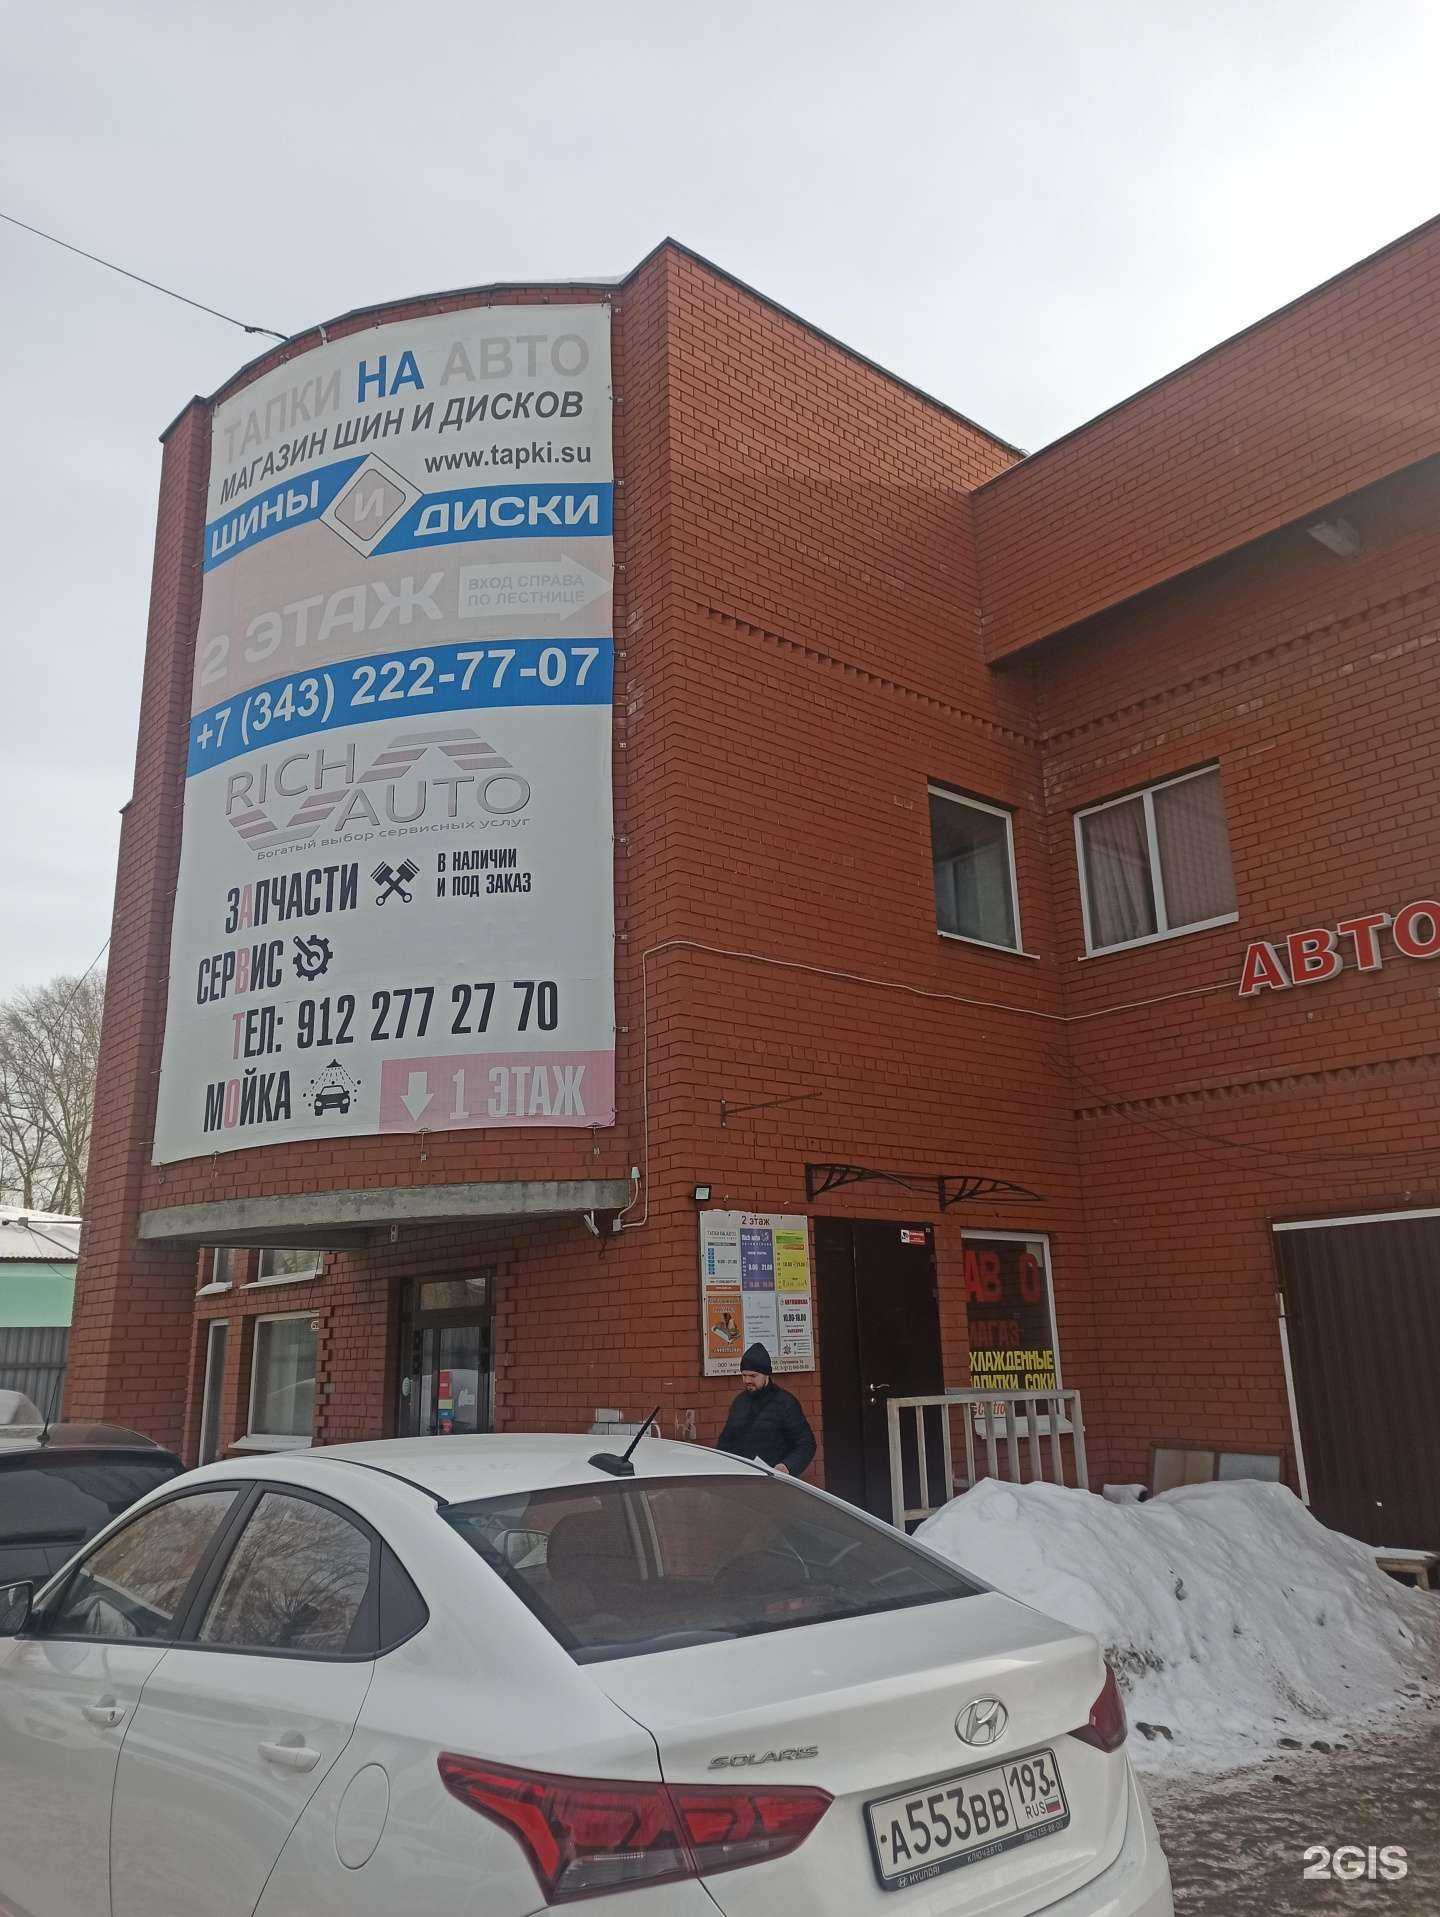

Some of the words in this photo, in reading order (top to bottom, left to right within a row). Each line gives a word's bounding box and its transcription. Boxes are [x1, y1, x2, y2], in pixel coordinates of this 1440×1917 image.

[223, 369, 341, 463] ТАПКИ
[357, 351, 424, 402] НА
[439, 334, 589, 386] АВТО
[220, 428, 327, 505] МАГАЗИН
[333, 407, 401, 450] ШИН
[411, 402, 434, 432] И
[438, 390, 584, 434] ДИСКОВ
[424, 442, 592, 474] www.tapki.su
[211, 479, 319, 558] ШИНЫ
[354, 487, 385, 522] И
[413, 494, 599, 537] ДИСКИ
[467, 576, 514, 592] ВХОД
[517, 574, 585, 589] СПРАВА
[467, 591, 490, 606] ПО
[494, 588, 587, 606] ЛЕСТНИЦЕ
[201, 633, 230, 684] 2
[244, 571, 445, 662] ЭТАЖ
[196, 706, 232, 751] +7
[241, 673, 335, 741] (343)
[350, 646, 600, 707] 222-77-07
[225, 743, 357, 815] RICH
[333, 772, 532, 832] AUTO
[257, 838, 317, 861] Богатый
[320, 831, 374, 847] выбор
[378, 819, 475, 839] сервисных
[480, 816, 532, 830] услуг
[437, 852, 447, 872] В
[452, 848, 517, 871] НАЛИЧИИ
[224, 862, 359, 935] ЗАПЧАСТИ
[437, 876, 446, 897] И
[452, 875, 480, 897] ПОД
[485, 872, 532, 894] ЗАКАЗ
[196, 939, 285, 1006] СЕРВИС
[1238, 899, 1440, 997] АВТО
[232, 1004, 283, 1062] ТЕЛ:
[296, 995, 356, 1049] 912
[370, 986, 435, 1041] 277
[451, 982, 496, 1035] 27
[512, 980, 559, 1033] 70
[203, 1067, 292, 1133] МОЙКА
[450, 1068, 471, 1120] 1
[487, 1065, 587, 1118] ЭТАЖ
[741, 1215, 748, 1225] 2
[749, 1217, 771, 1226] этаж
[969, 1350, 1054, 1371] ХЛАЖДЕННЫЕ
[970, 1374, 1019, 1390] АПИТКИ
[708, 1745, 819, 1770] SOLARIS
[1009, 1758, 1051, 1805] 193
[1025, 1802, 1047, 1819] RUS
